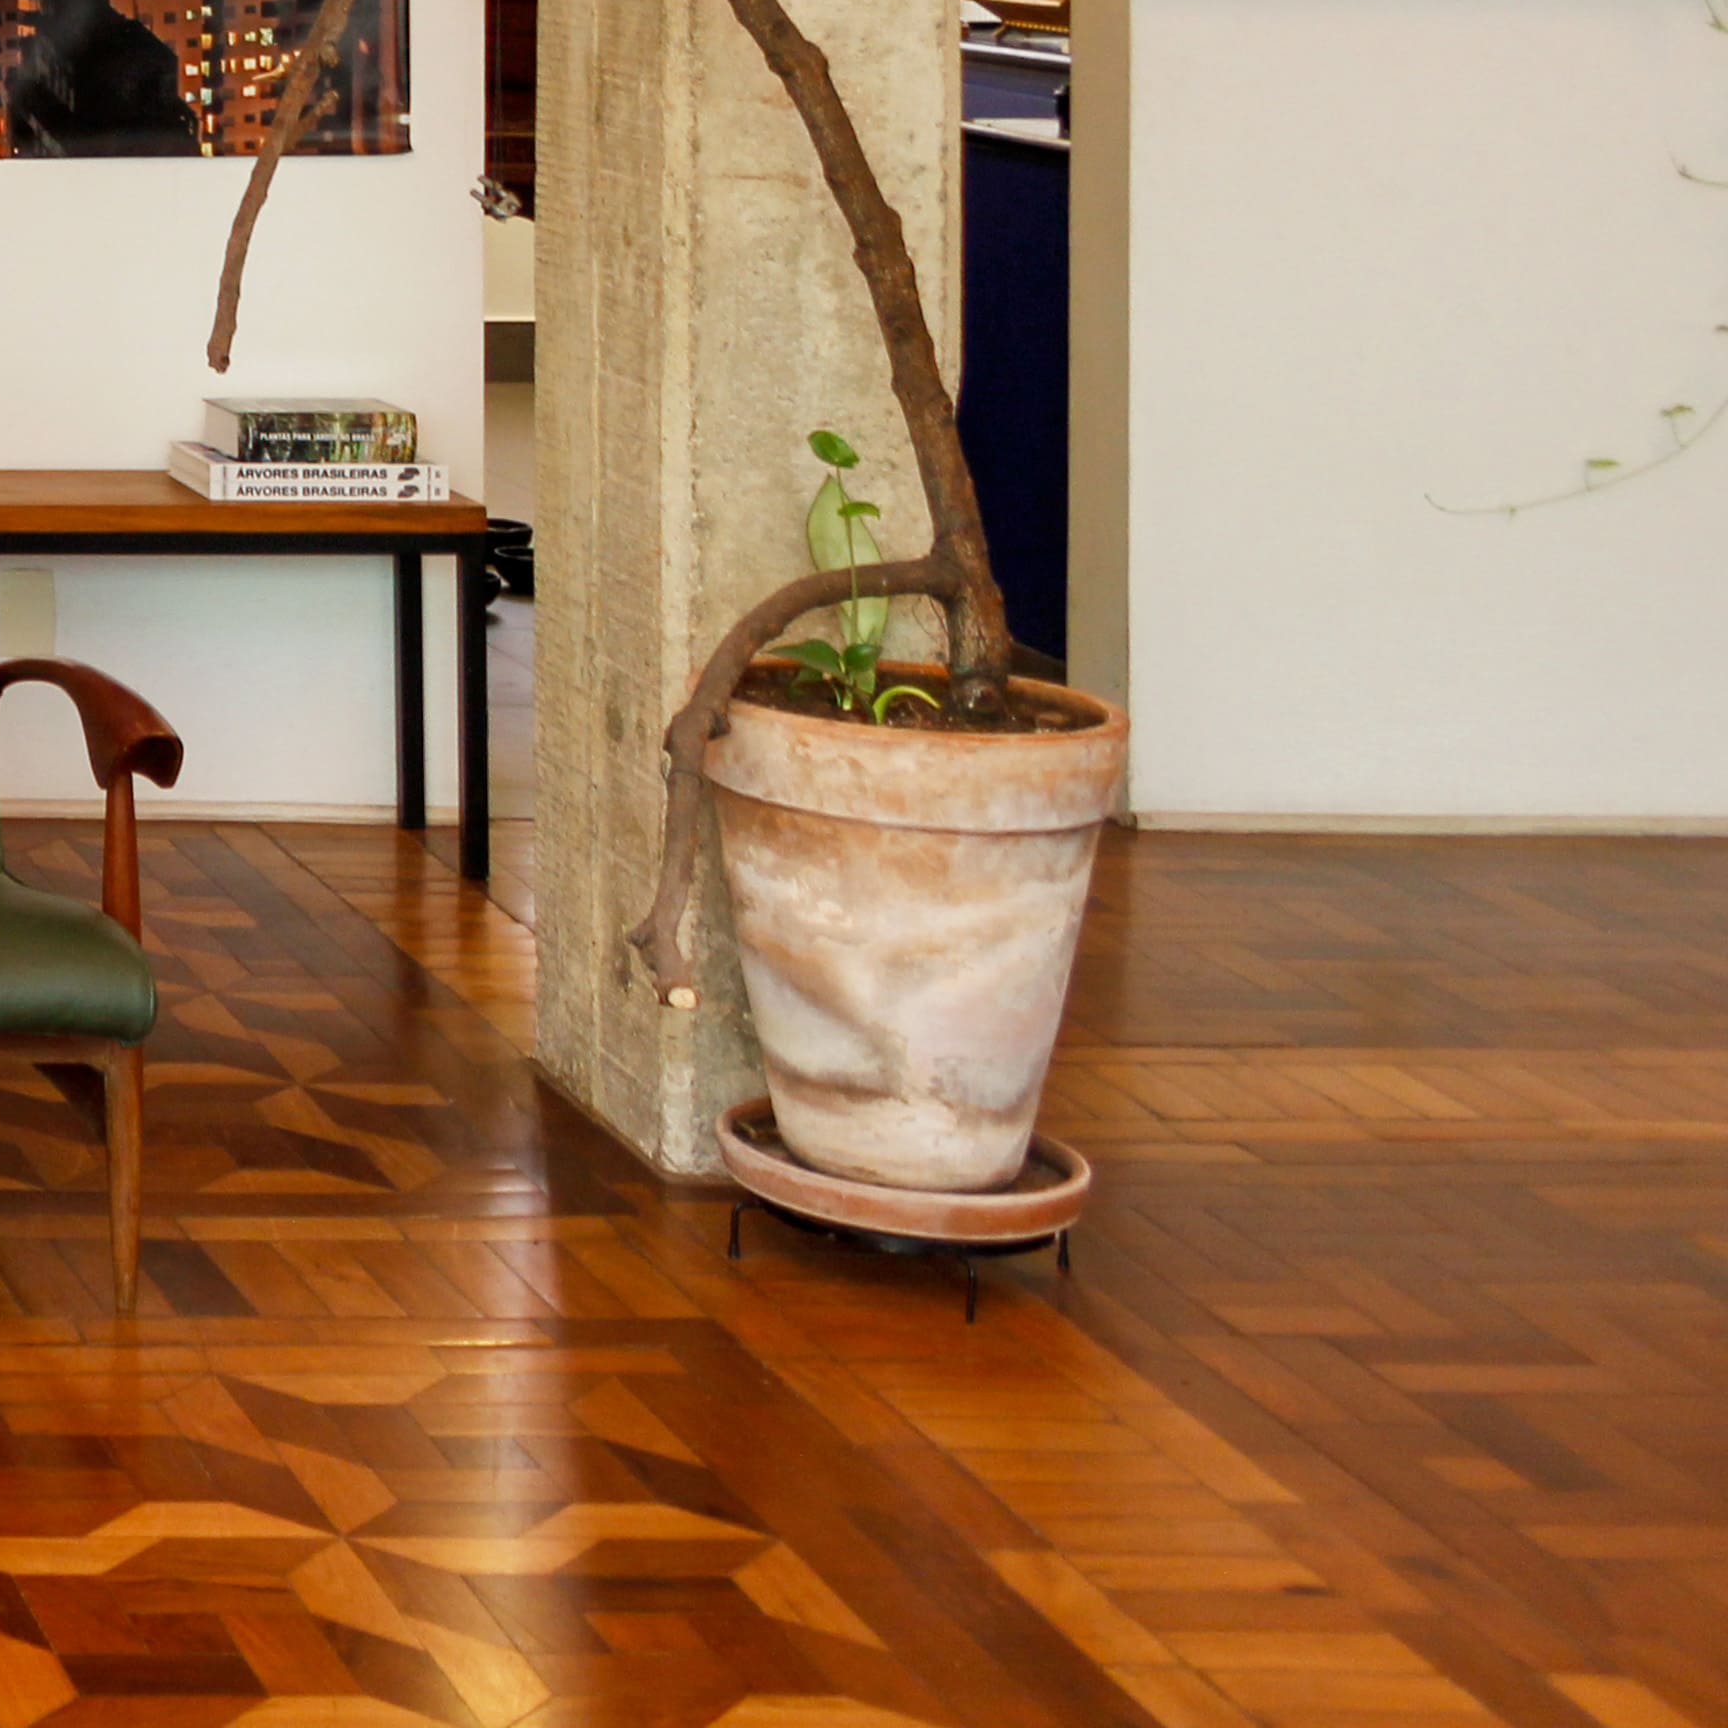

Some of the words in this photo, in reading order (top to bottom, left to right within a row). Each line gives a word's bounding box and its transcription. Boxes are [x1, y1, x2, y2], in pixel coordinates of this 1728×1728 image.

[259, 432, 291, 441] PLANTAS
[236, 467, 299, 480] ÁRVORES
[302, 468, 388, 480] BRASILEIRAS
[236, 485, 299, 497] ÁRVORES
[302, 486, 388, 497] BRASILEIRAS
